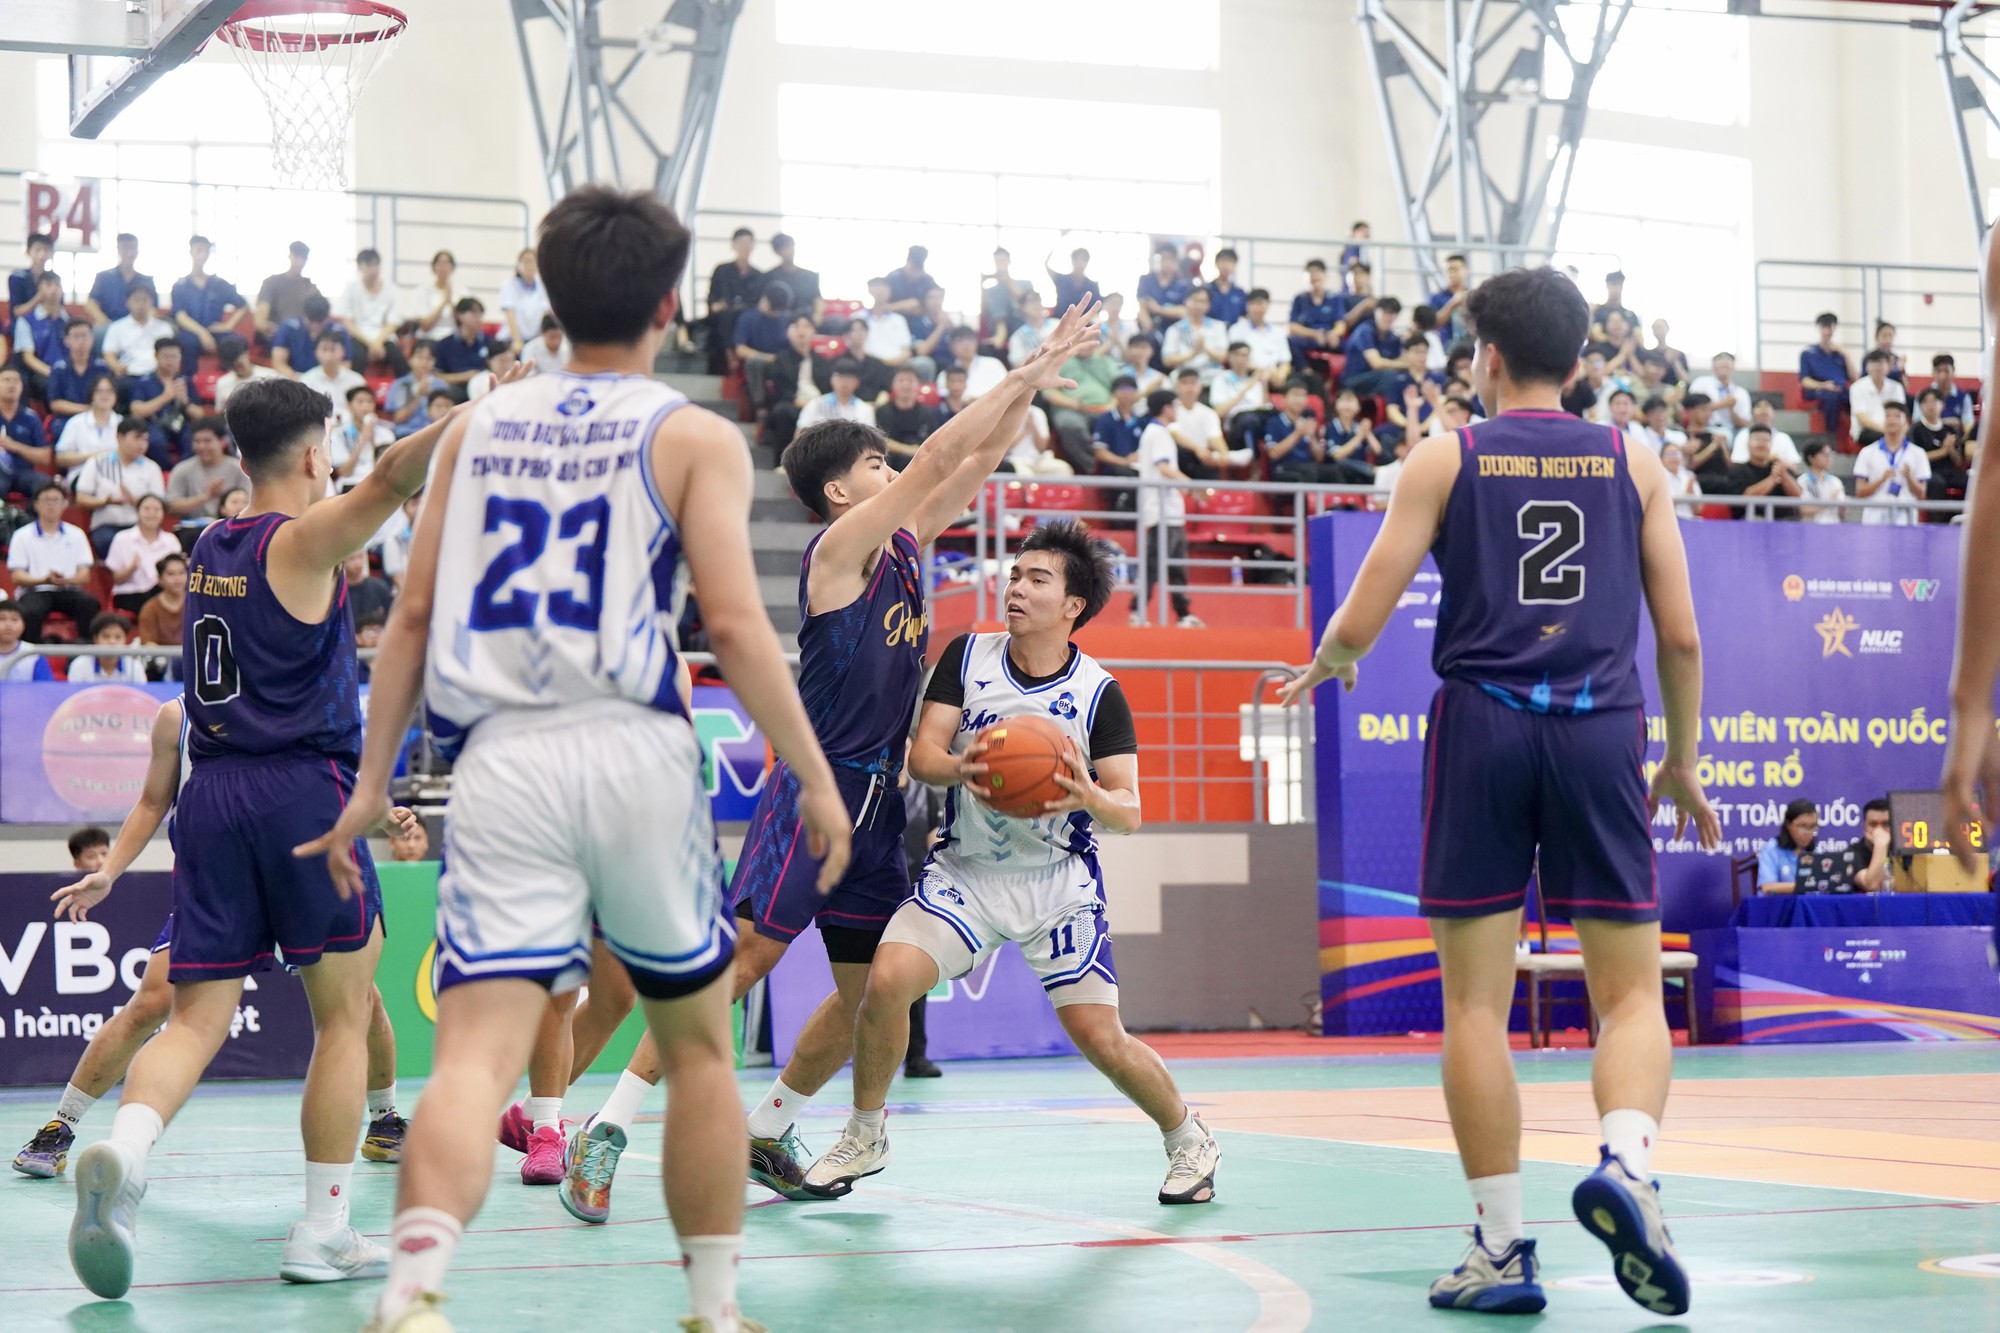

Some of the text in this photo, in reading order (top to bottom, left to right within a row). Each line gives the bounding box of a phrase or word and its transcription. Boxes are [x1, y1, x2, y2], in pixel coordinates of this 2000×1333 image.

[29, 183, 96, 246] B4
[1478, 455, 1615, 478] DUONG NGUYEN
[468, 494, 611, 632] 23
[1517, 500, 1585, 605] 2
[1899, 578, 1941, 601] VTV
[1859, 630, 1903, 647] NUC
[194, 614, 240, 706] 0
[960, 708, 1005, 733] BÁC
[1359, 713, 1409, 744] ĐẠI
[1709, 710, 1777, 743] VIÊN
[1784, 711, 1860, 743] TOÀN
[1867, 707, 1946, 748] QUỐC
[1696, 754, 1756, 787] ÓNG
[1763, 748, 1804, 788] RỔ
[1815, 797, 1860, 827] UỐC
[1901, 821, 1928, 848] 50
[1049, 924, 1076, 960] 11
[14, 996, 103, 1041] hàng
